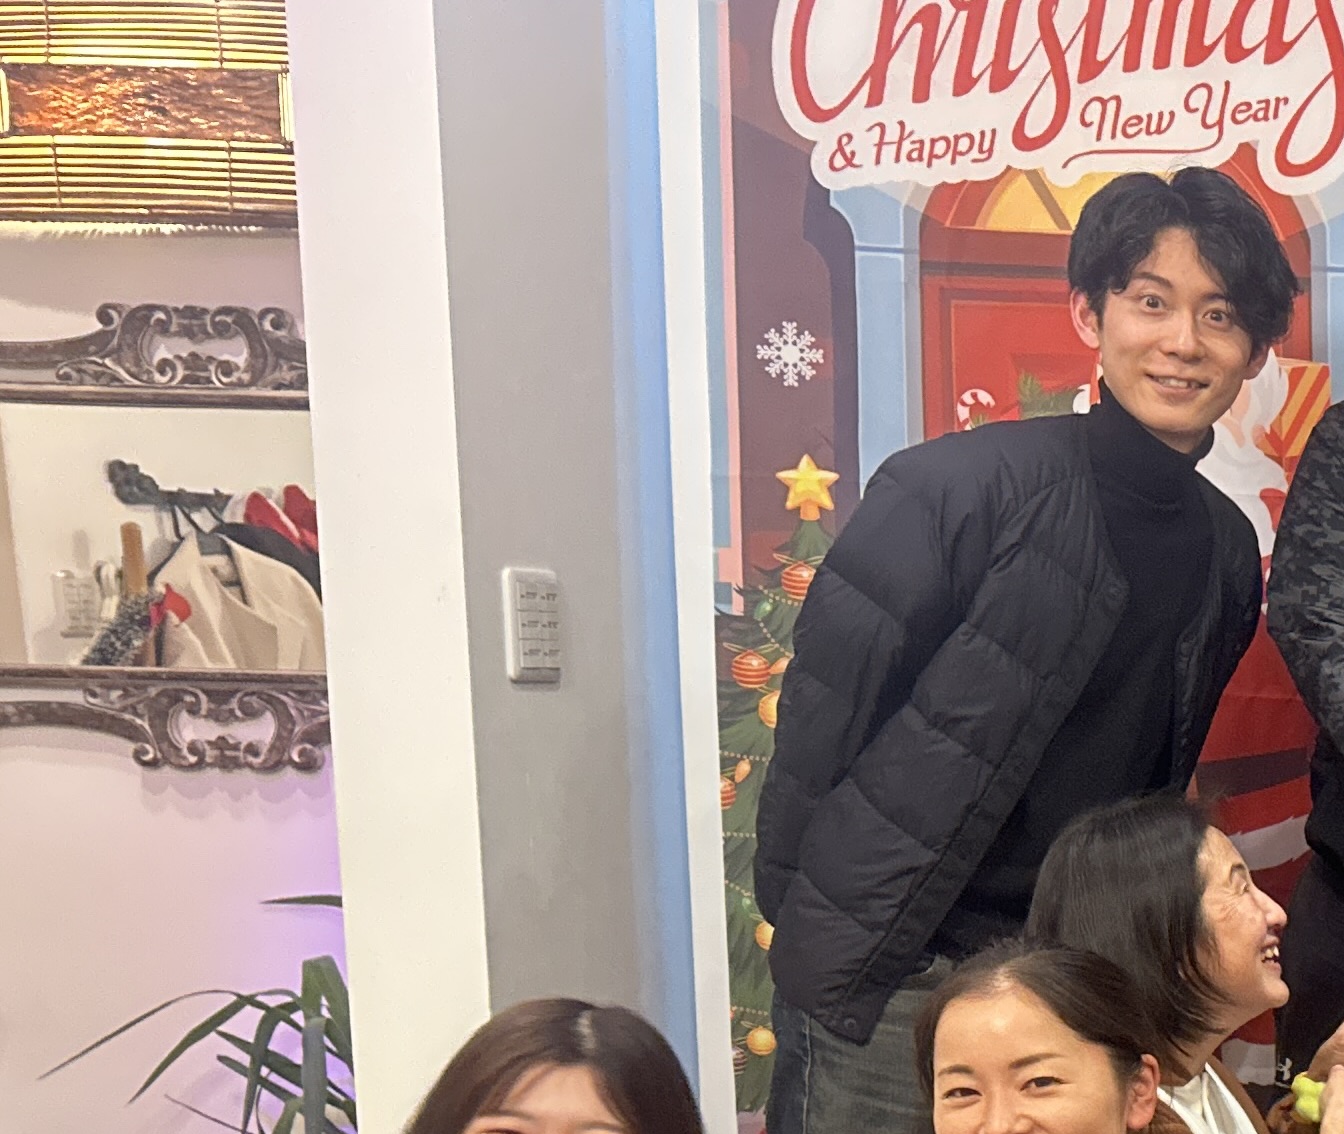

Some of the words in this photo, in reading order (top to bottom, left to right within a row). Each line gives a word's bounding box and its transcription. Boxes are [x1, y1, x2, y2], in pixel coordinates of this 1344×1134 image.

[827, 133, 862, 172] &
[865, 121, 997, 167] Happy
[1080, 95, 1175, 142] New
[1183, 80, 1289, 149] Year
